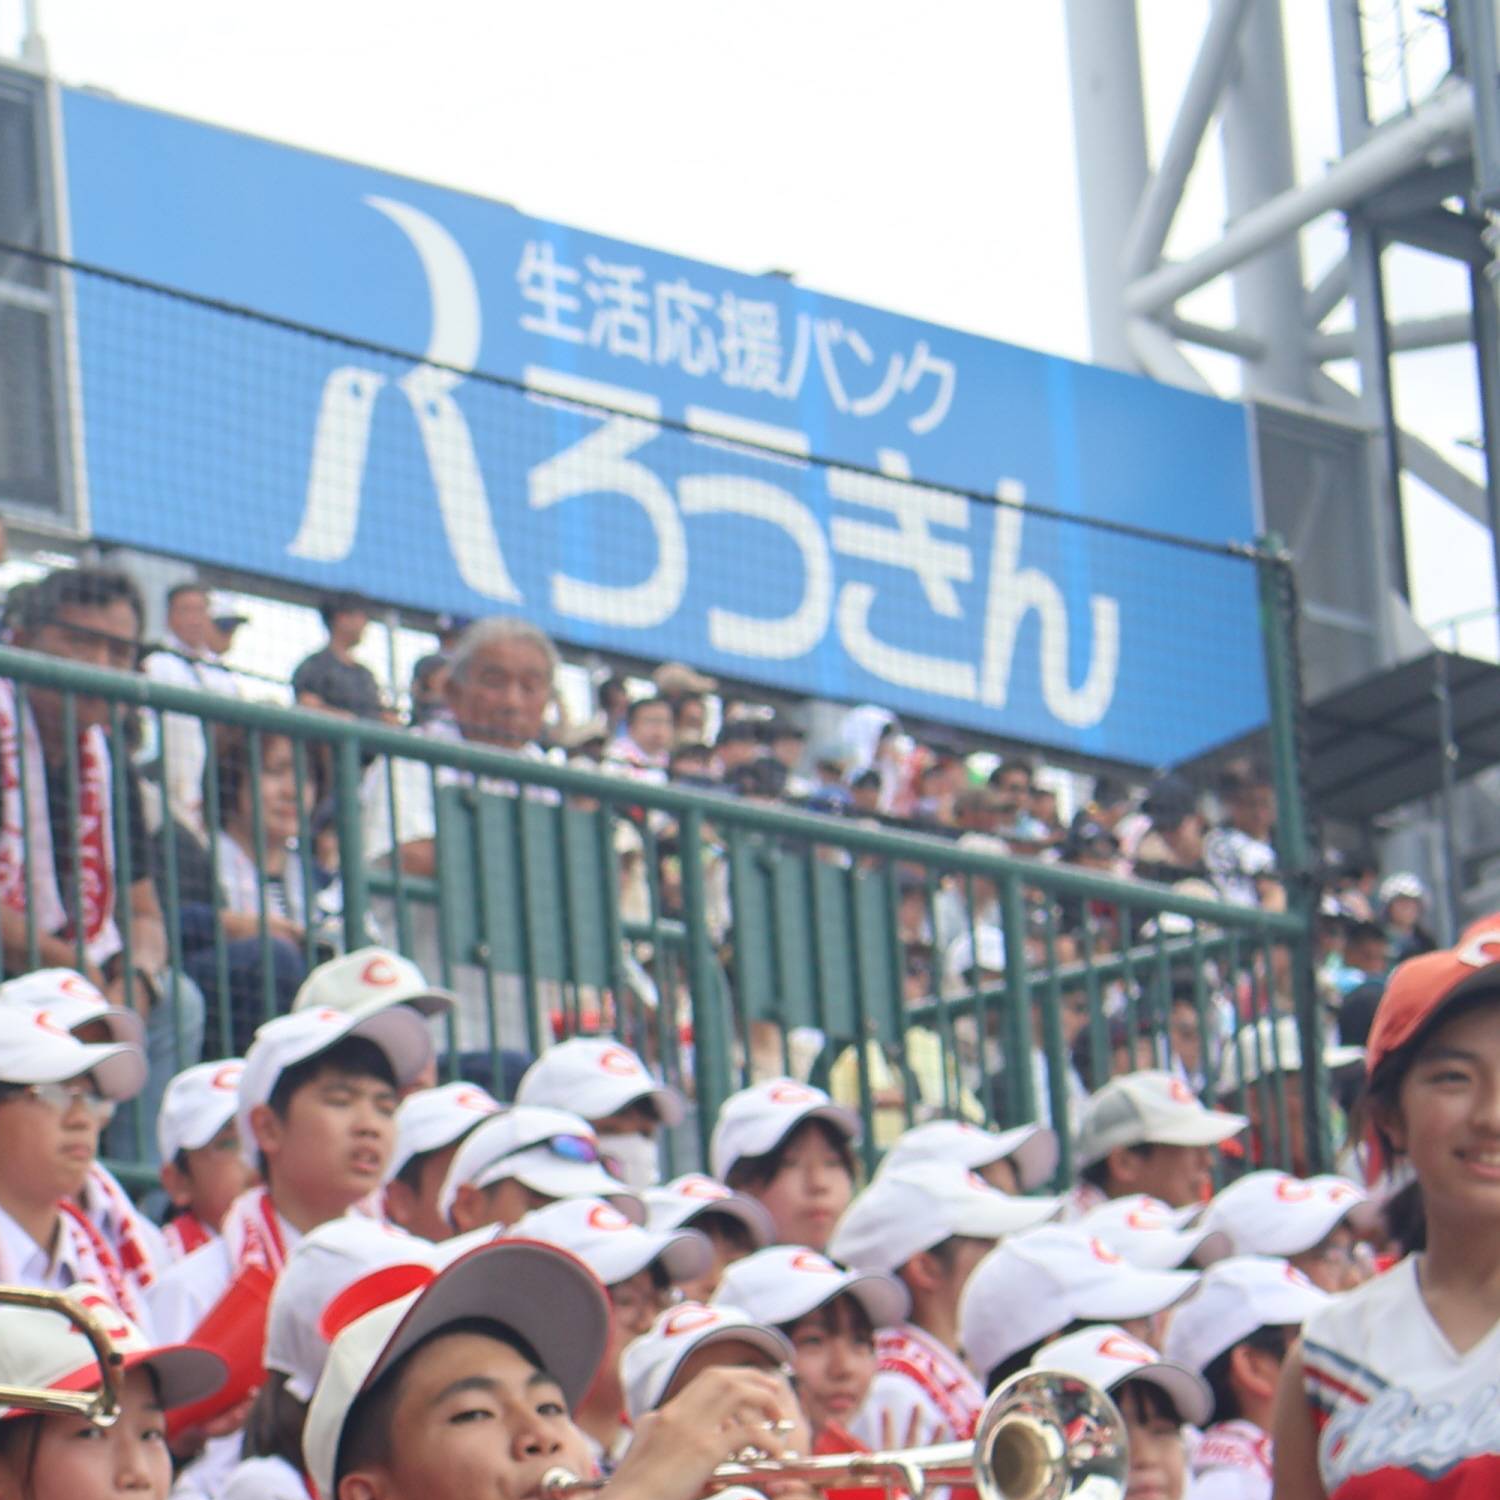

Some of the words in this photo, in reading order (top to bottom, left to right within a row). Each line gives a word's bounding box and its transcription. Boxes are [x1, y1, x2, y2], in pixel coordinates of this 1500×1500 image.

[515, 238, 958, 436] 生活応援バンク
[524, 366, 1119, 729] ろうきん
